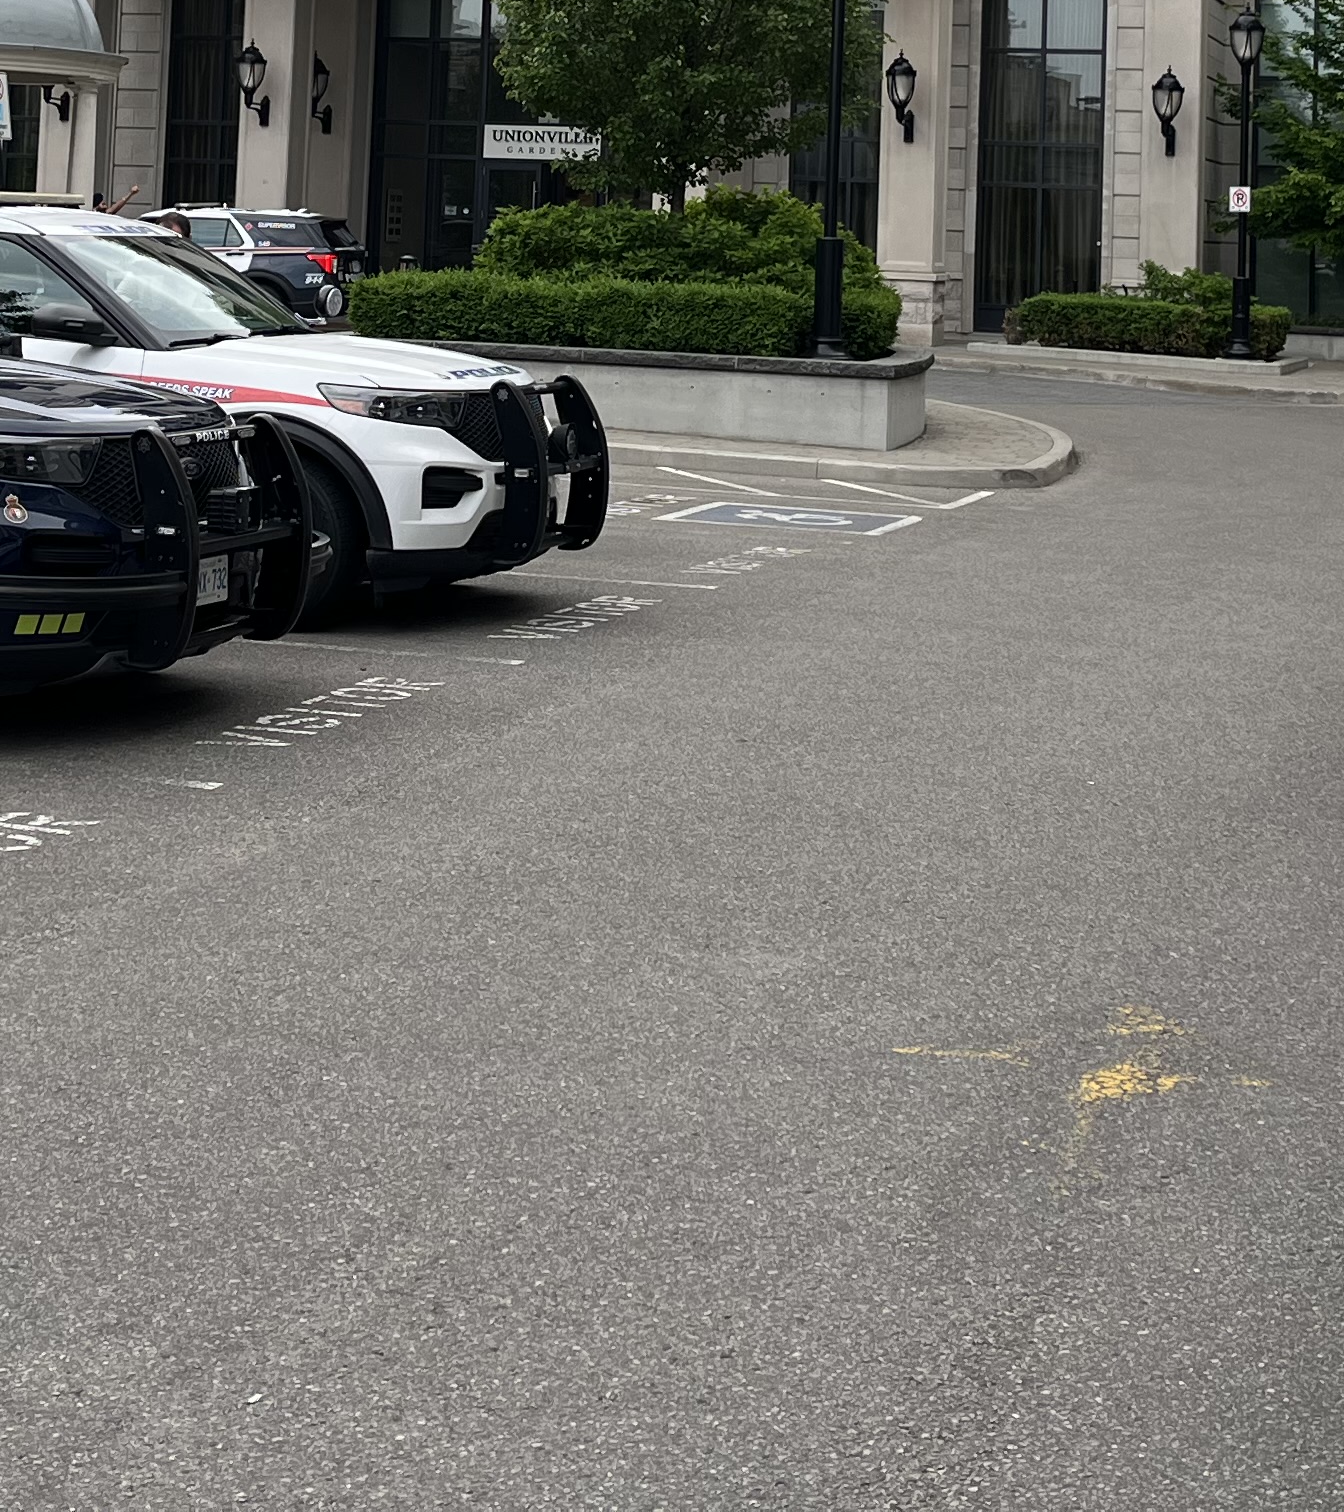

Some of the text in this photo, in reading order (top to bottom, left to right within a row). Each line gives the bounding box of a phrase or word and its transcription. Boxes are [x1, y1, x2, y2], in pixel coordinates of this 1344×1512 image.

[196, 429, 229, 442] POLICE
[487, 596, 662, 638] VISITOR
[194, 677, 446, 747] VISITOR
